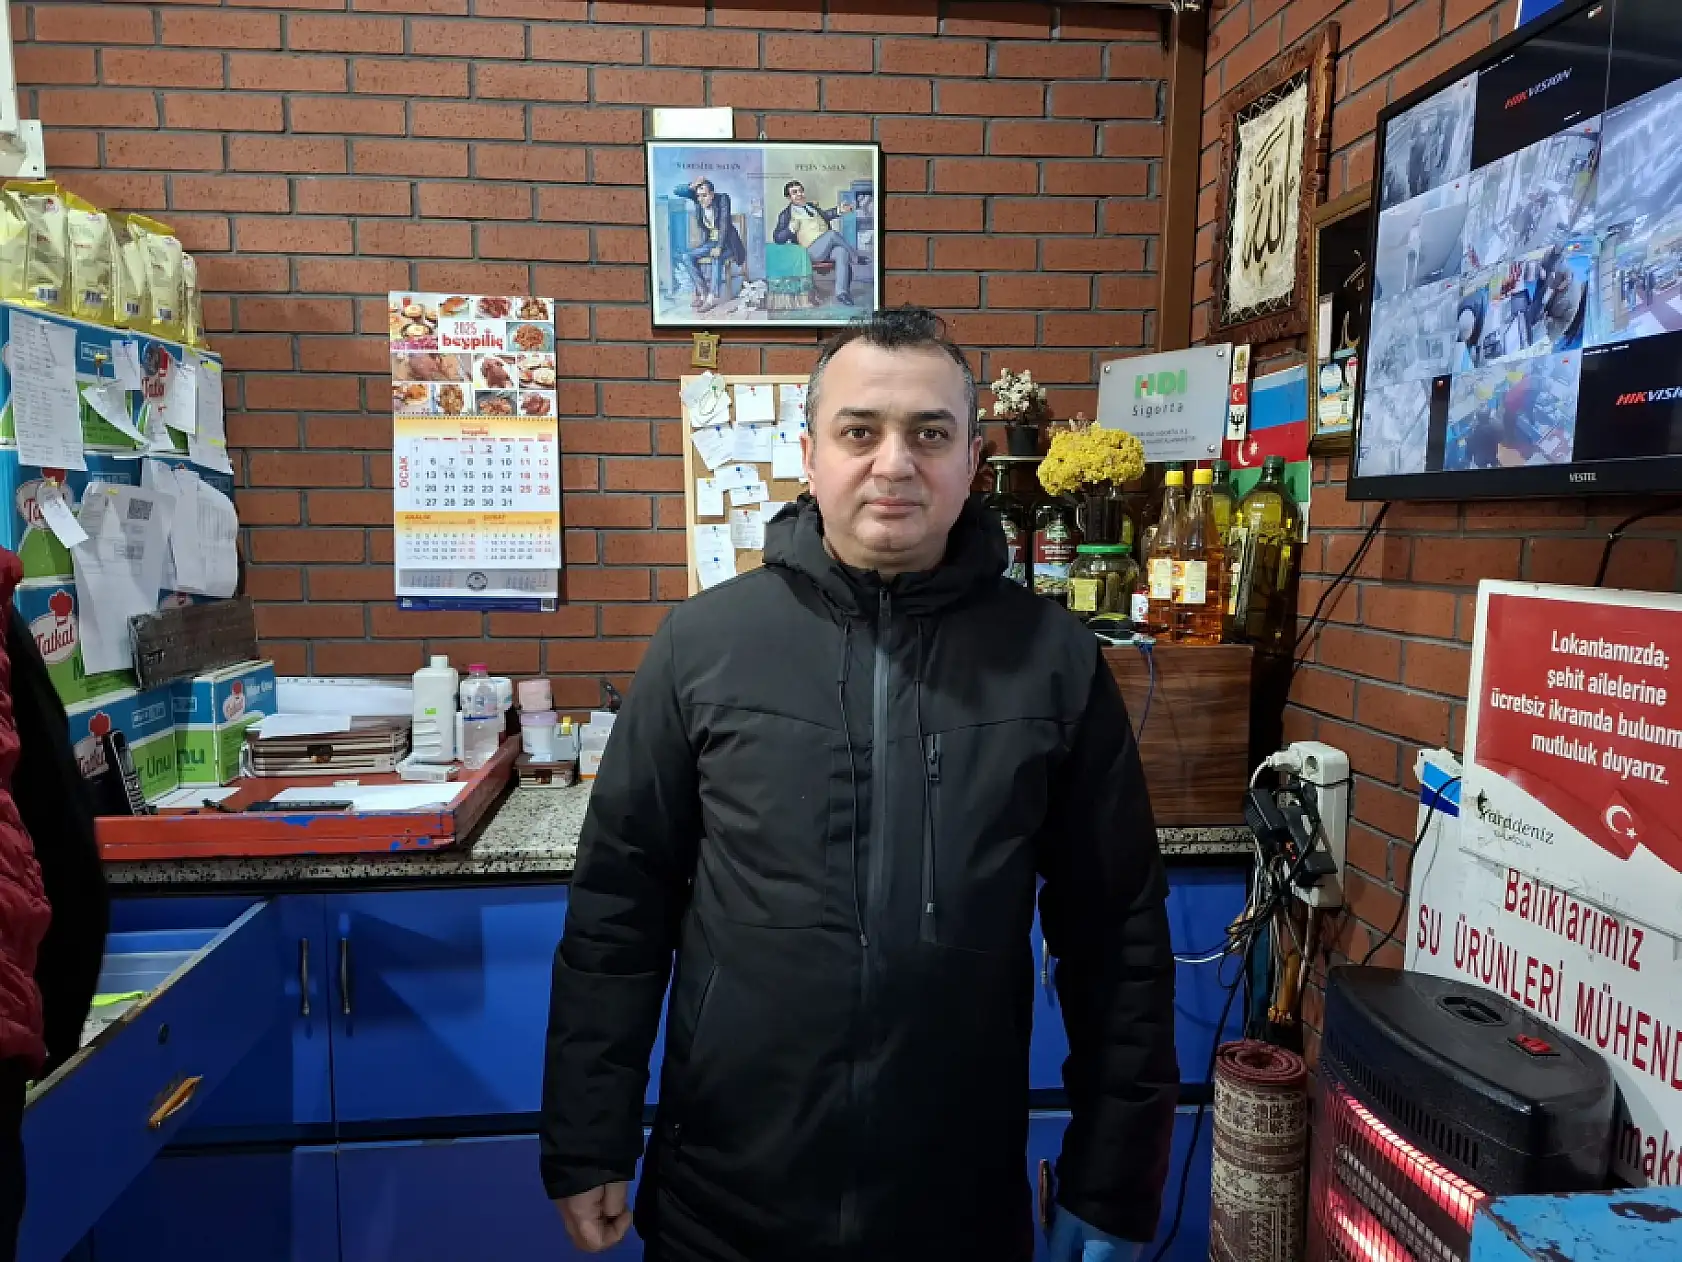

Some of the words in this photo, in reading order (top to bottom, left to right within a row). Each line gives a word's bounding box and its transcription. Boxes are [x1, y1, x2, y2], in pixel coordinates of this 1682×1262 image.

[1505, 67, 1572, 109] HIKVISION
[1135, 369, 1187, 398] HDI
[1132, 402, 1184, 419] Sigorta
[399, 456, 409, 488] OCAK
[1569, 472, 1597, 482] VESTEL
[1547, 666, 1585, 691] şehit
[1587, 672, 1667, 706] ailelerine
[1491, 687, 1546, 718] ücretsiz
[1549, 698, 1613, 733] ikramda
[1531, 733, 1597, 766] mutluluk
[1602, 747, 1670, 785] duyarız.
[1504, 867, 1644, 971] Balıklarımız
[1418, 904, 1443, 955] SU
[1453, 913, 1564, 1022] ÜRÜNLERİ
